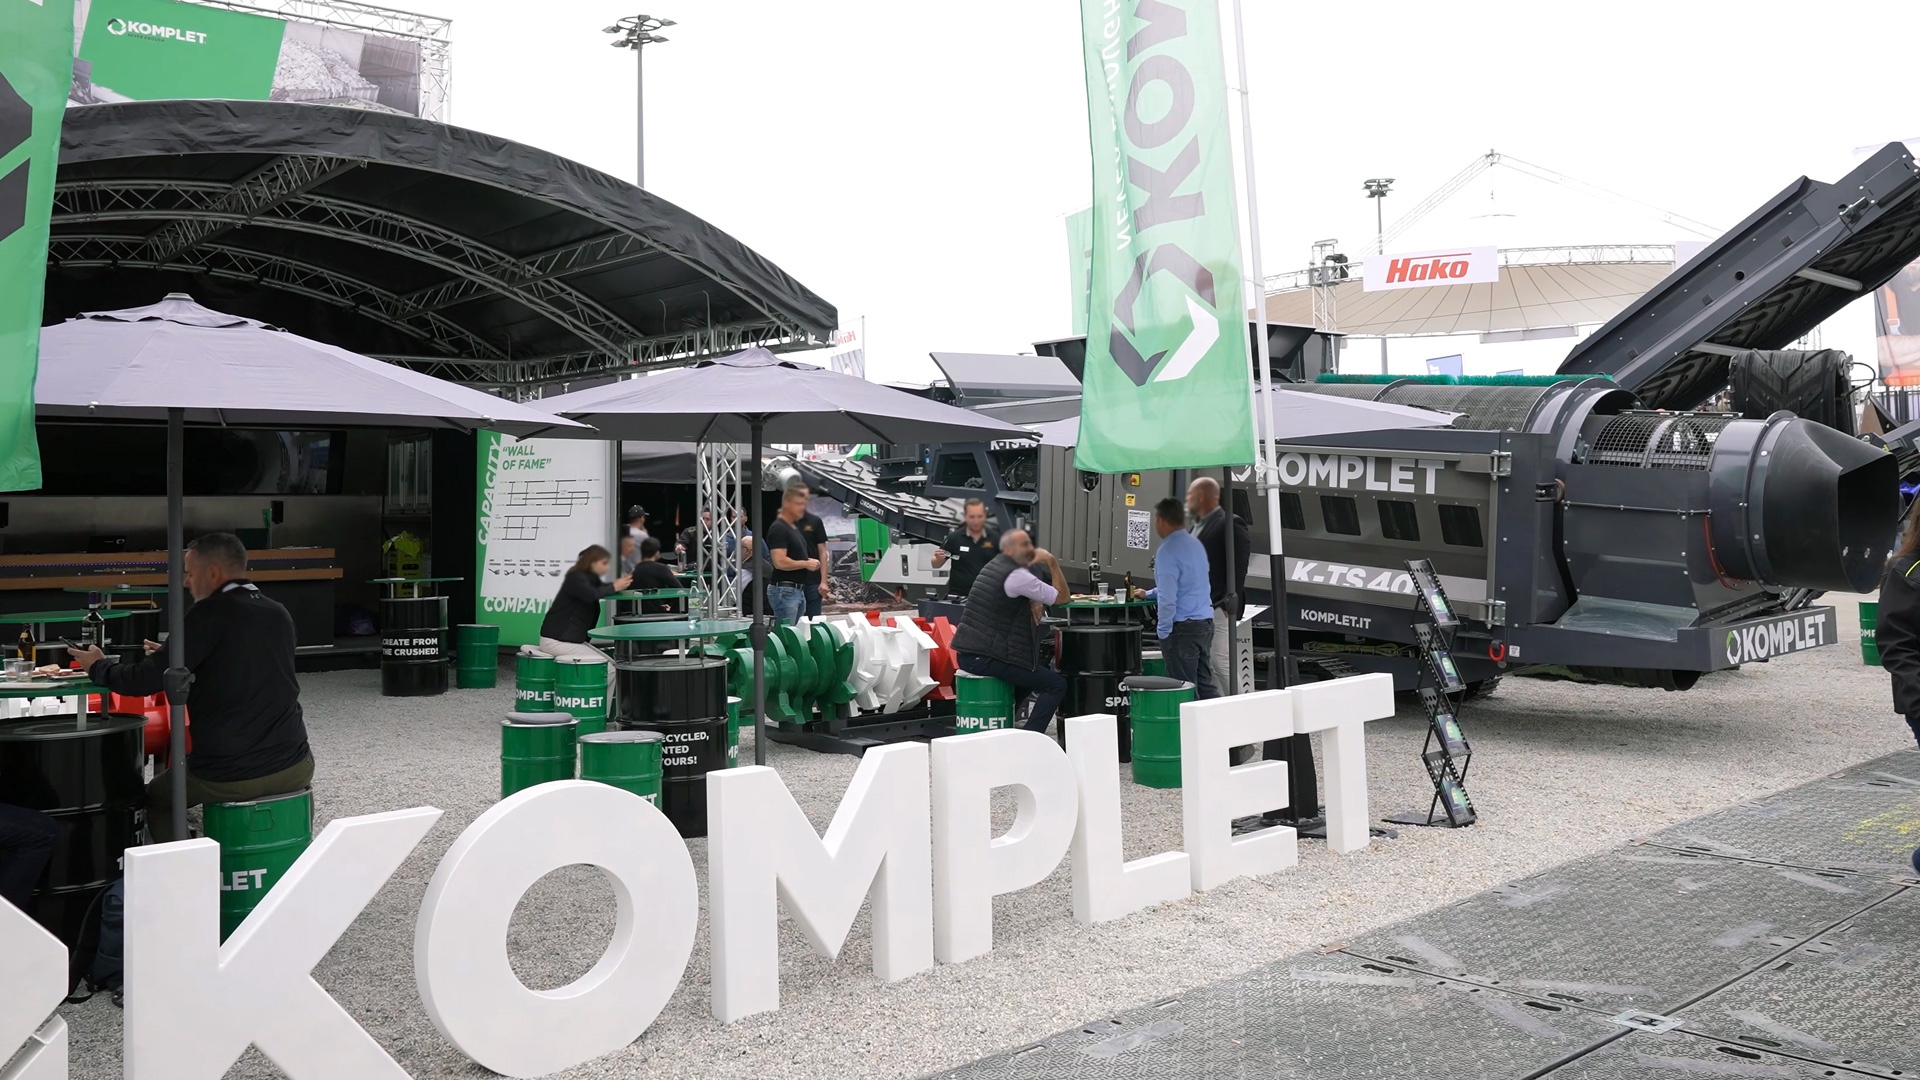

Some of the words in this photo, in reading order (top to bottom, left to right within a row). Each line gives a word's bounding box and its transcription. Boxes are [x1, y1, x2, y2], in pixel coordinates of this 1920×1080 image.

[128, 20, 207, 44] KOMPLET
[1386, 255, 1470, 283] Hako
[502, 460, 516, 470] OF
[478, 436, 500, 545] CAPACITY
[484, 597, 554, 613] COMPATI
[1301, 609, 1371, 629] KOMPLET.IT
[382, 638, 410, 646] CREATE
[412, 637, 438, 646] FROM
[1742, 614, 1826, 661] KOMPLET
[394, 647, 439, 656] CRUSHED!
[1105, 696, 1131, 707] SPA
[124, 672, 1396, 1080] KOMPLET
